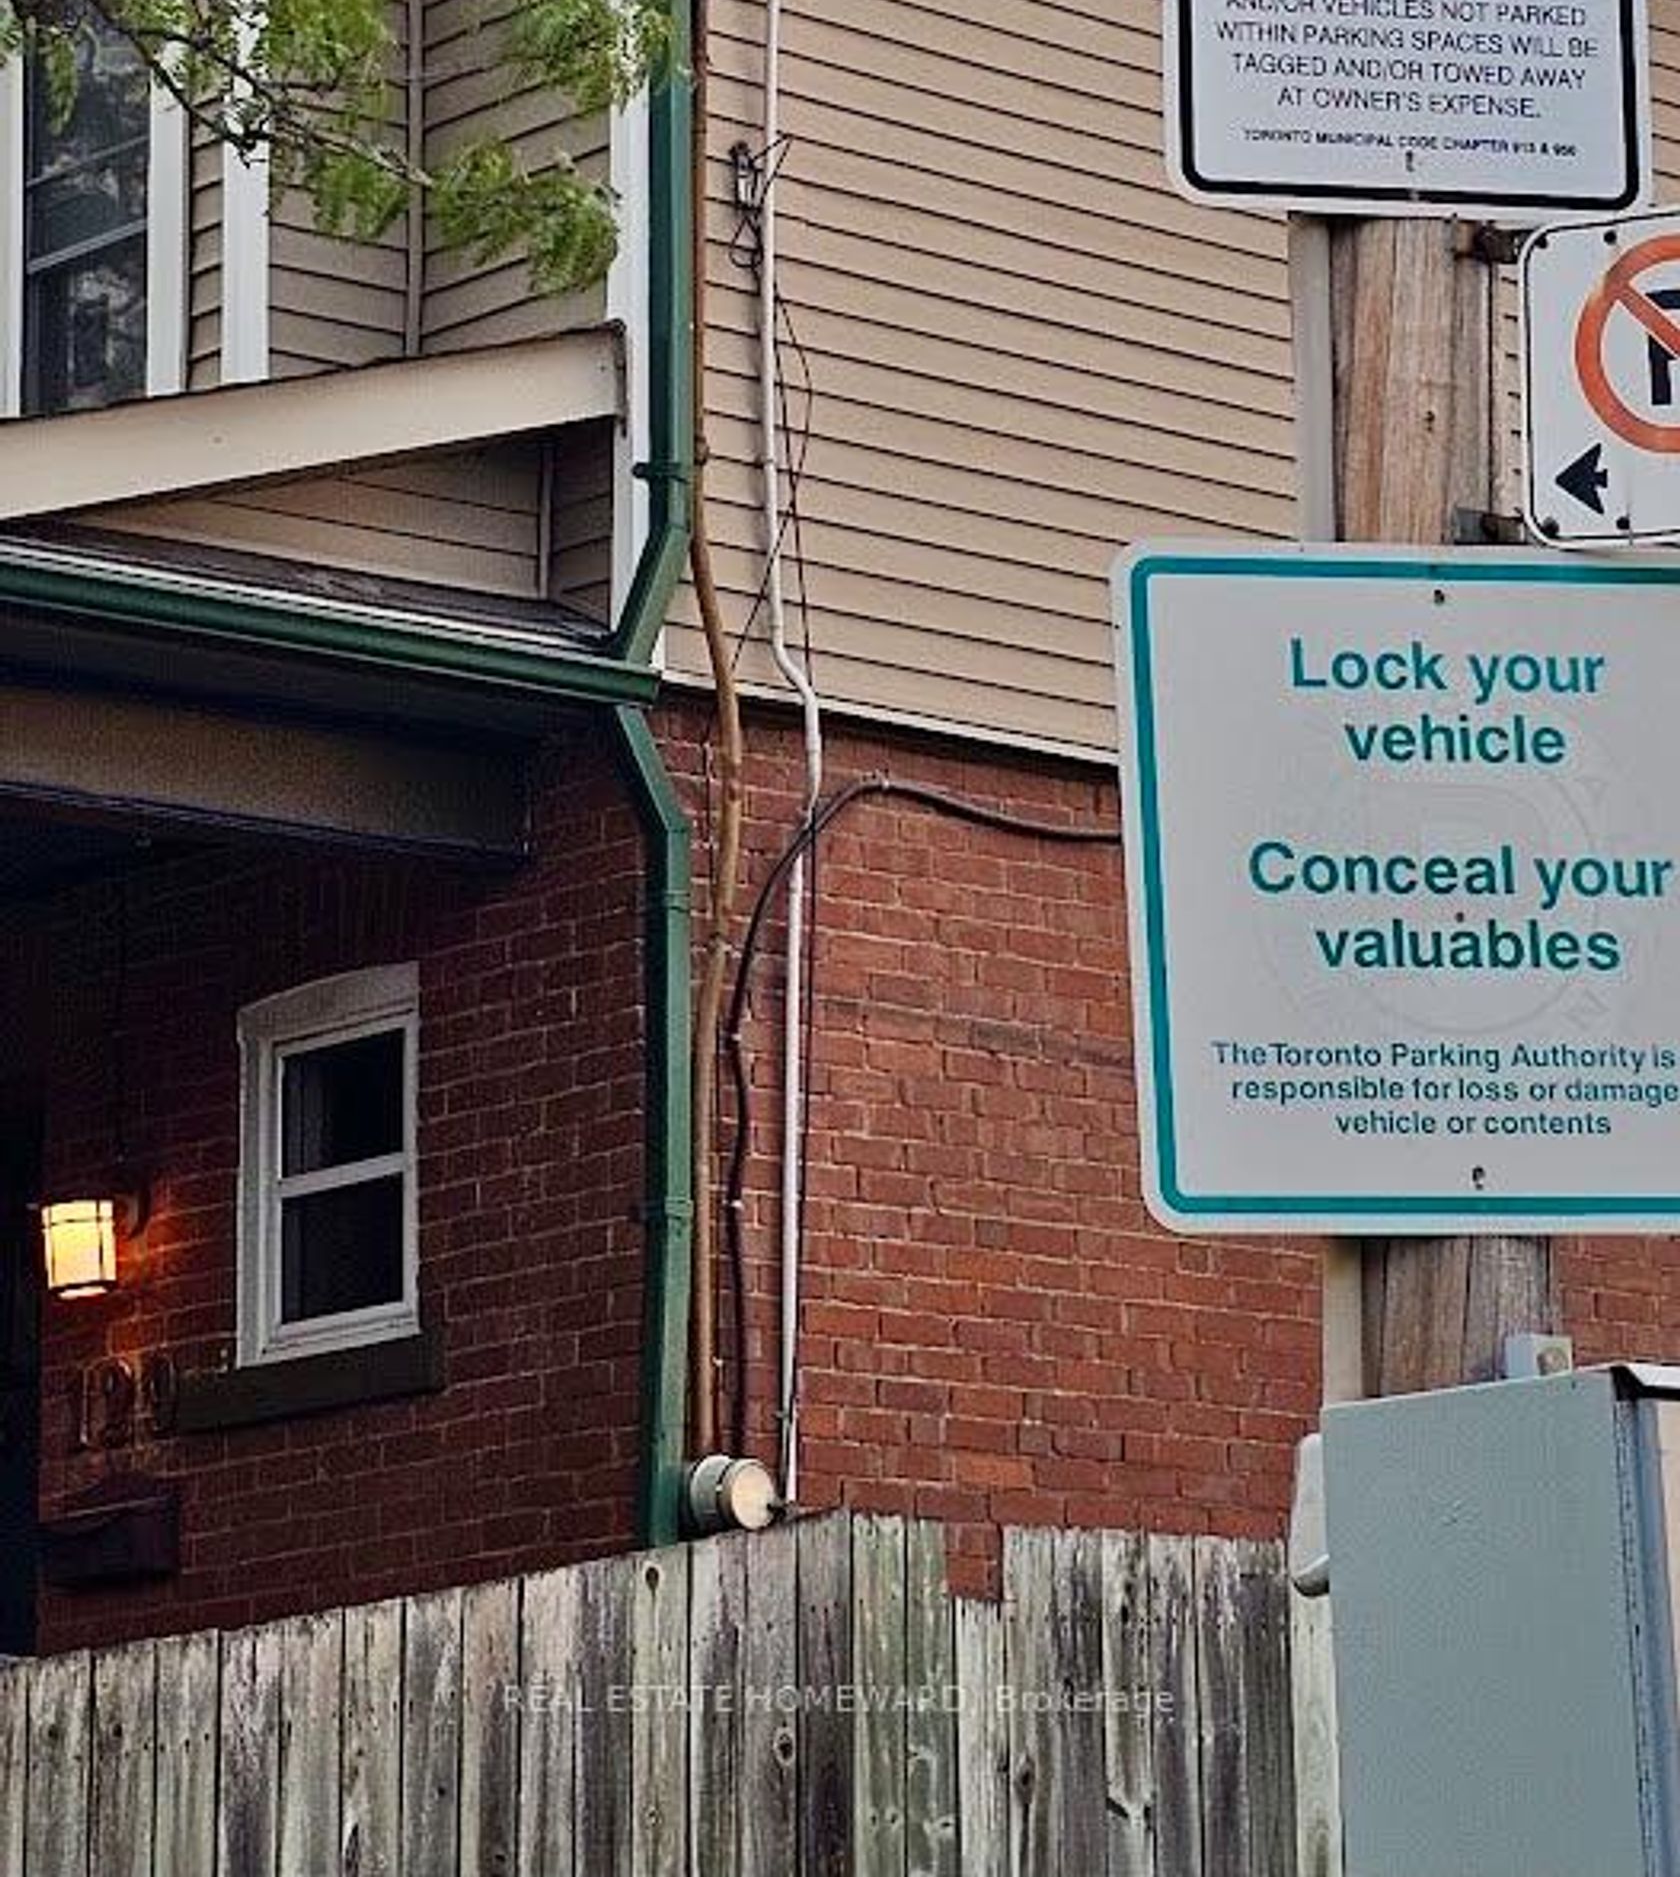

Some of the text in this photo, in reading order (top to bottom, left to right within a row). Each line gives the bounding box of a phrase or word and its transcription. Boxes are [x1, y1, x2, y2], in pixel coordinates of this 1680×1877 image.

[1440, 1, 1492, 23] NOT
[1497, 4, 1587, 26] PARKED
[1215, 21, 1599, 58] WITHIN PARKING SPACES WILL BE
[1232, 53, 1587, 90] TAGGED AND/OR TOWED AWAY
[1277, 87, 1542, 119] AT OWNER'S EXPENSE.
[1244, 129, 1311, 144] TORONTO
[1315, 130, 1395, 149] MUNICIPAL
[1398, 135, 1438, 150] CODE
[1442, 137, 1509, 154] CHAPTER
[1290, 636, 1606, 703] Lock your
[1343, 714, 1566, 764] vehicle
[1248, 840, 1674, 909] Conceal your
[1316, 919, 1621, 972] valuables
[1214, 1041, 1676, 1075] The Toronto Parking Authority is
[1230, 1076, 1680, 1109] responsible for loss or damage
[1336, 1111, 1612, 1137] vehicle or contents
